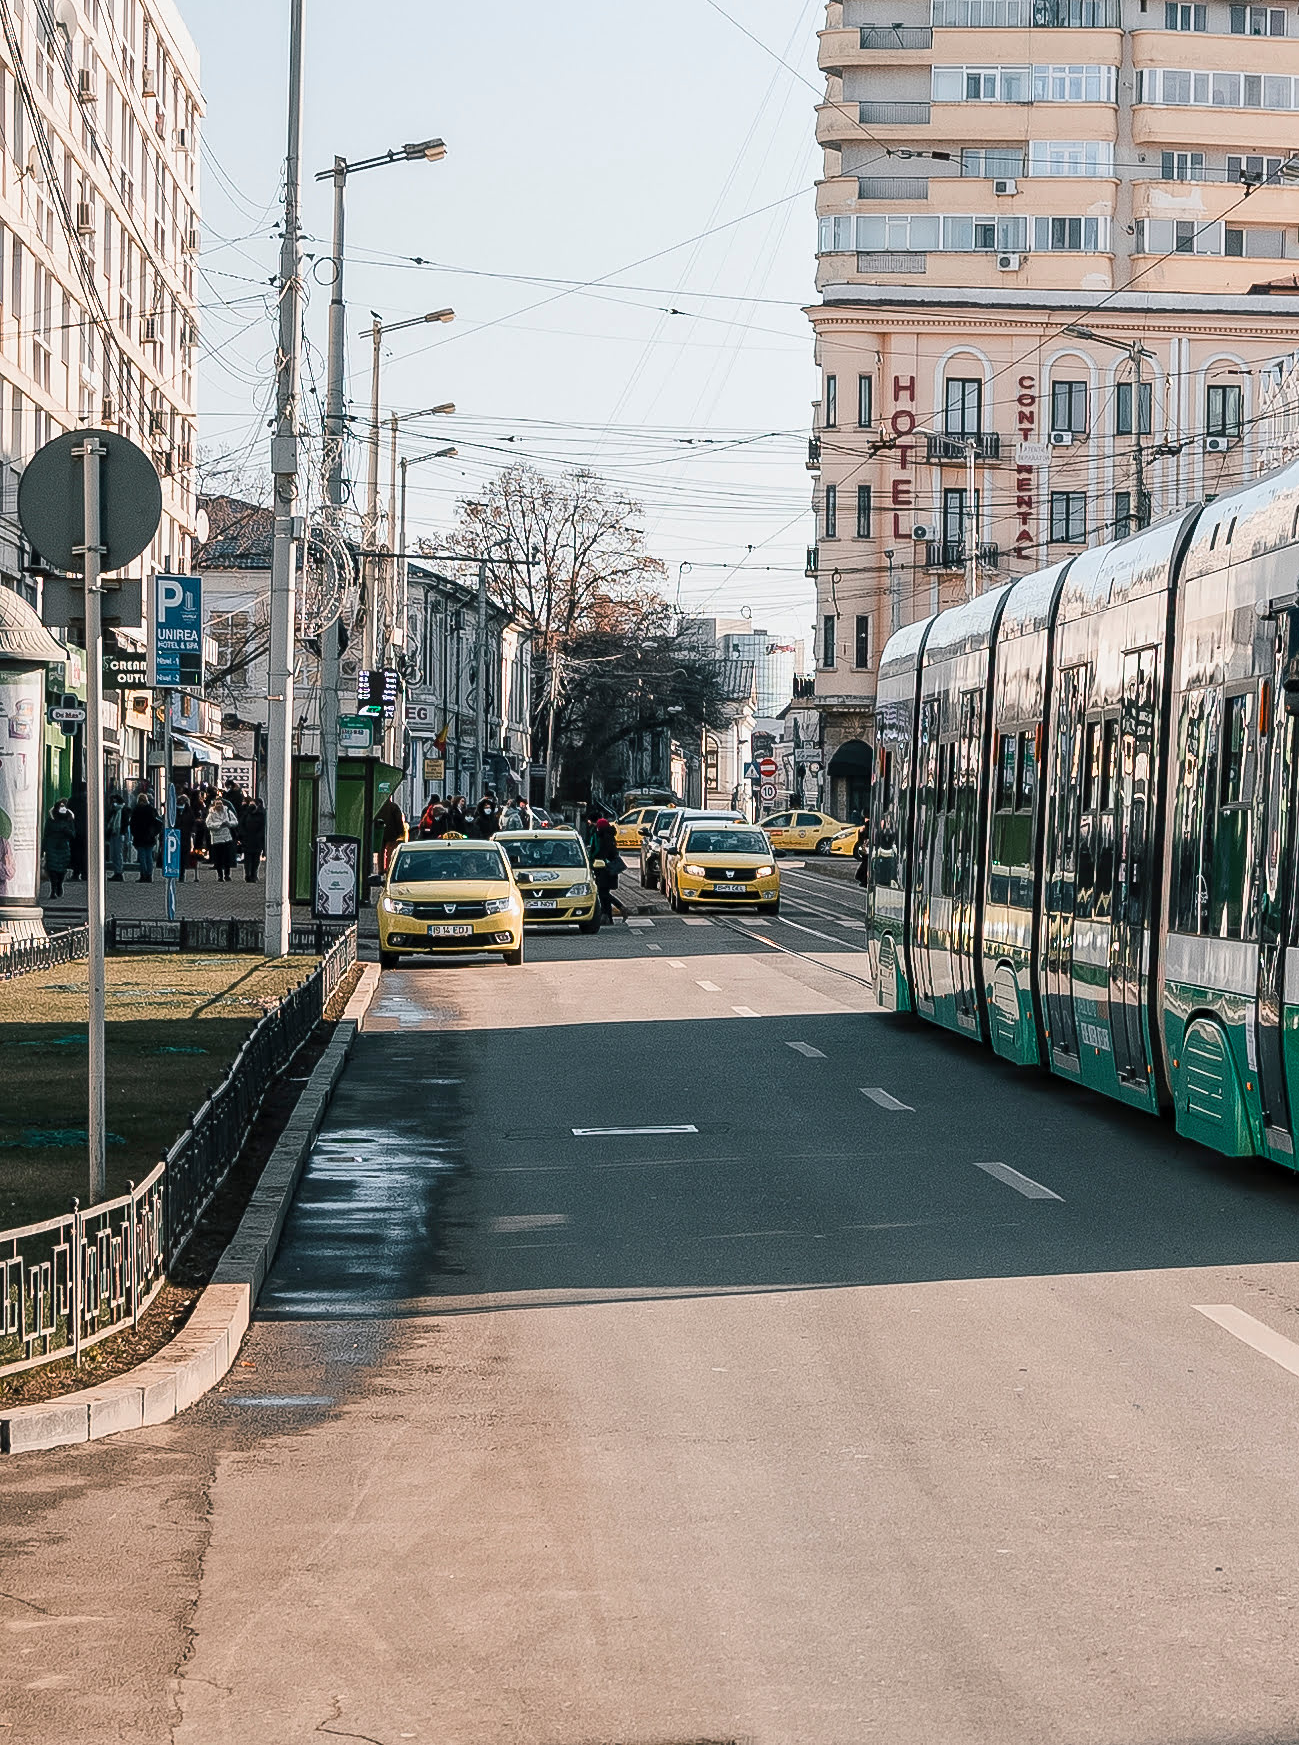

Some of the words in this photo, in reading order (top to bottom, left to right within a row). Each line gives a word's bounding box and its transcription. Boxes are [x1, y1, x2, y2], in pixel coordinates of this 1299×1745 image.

[891, 375, 916, 540] HOTEL
[1016, 376, 1036, 560] CONTNENTAL
[157, 579, 184, 623] P
[157, 628, 199, 641] UNIREA
[763, 787, 773, 795] 10
